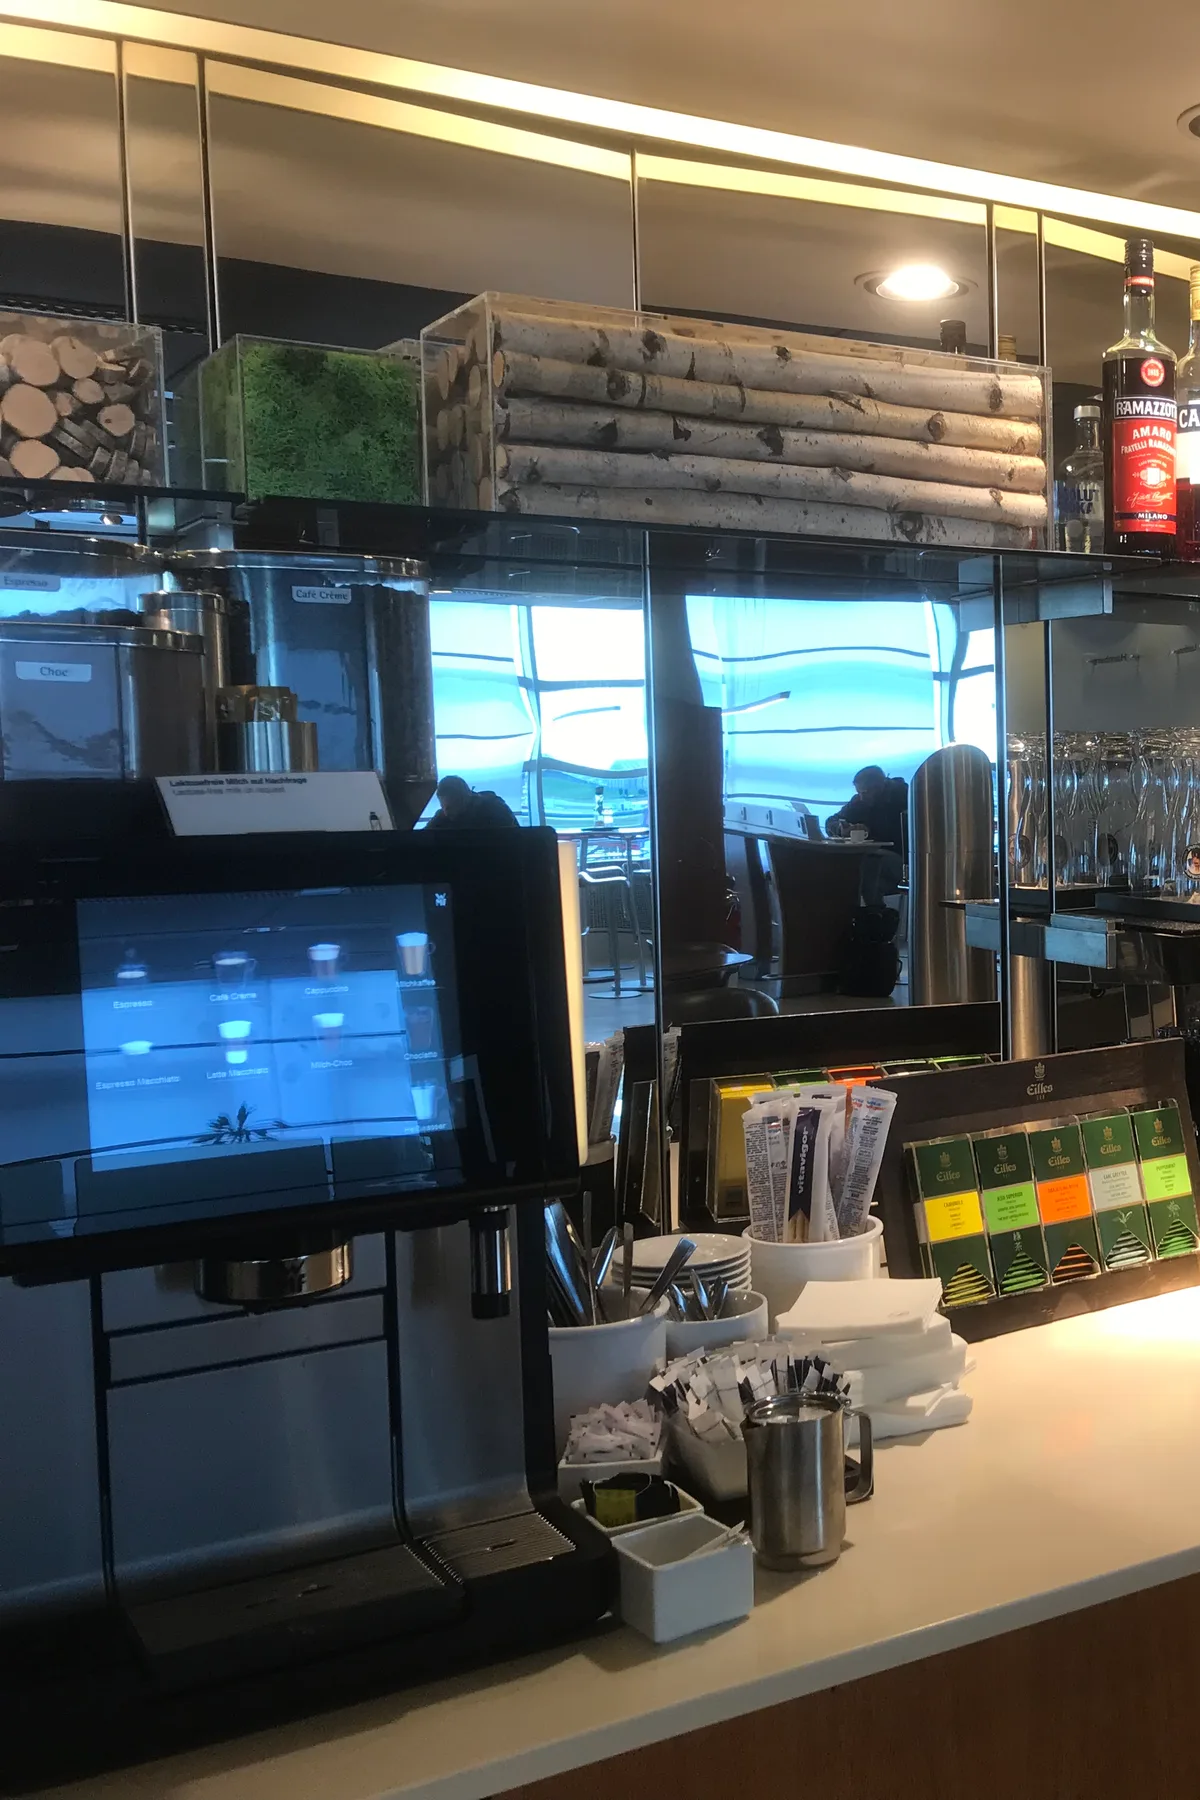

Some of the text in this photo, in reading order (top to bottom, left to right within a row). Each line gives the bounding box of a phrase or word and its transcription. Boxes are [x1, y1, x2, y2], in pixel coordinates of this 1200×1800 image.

[1132, 425, 1172, 441] AMARO
[1121, 440, 1148, 455] FRATELLI
[1138, 511, 1168, 520] MILANO
[296, 589, 348, 600] Café Crème
[40, 666, 69, 677] Choc
[305, 985, 349, 995] Cappuccino
[113, 1000, 153, 1009] Espresso
[1026, 1082, 1054, 1096] Eilles
[797, 1126, 810, 1194] vitavigor
